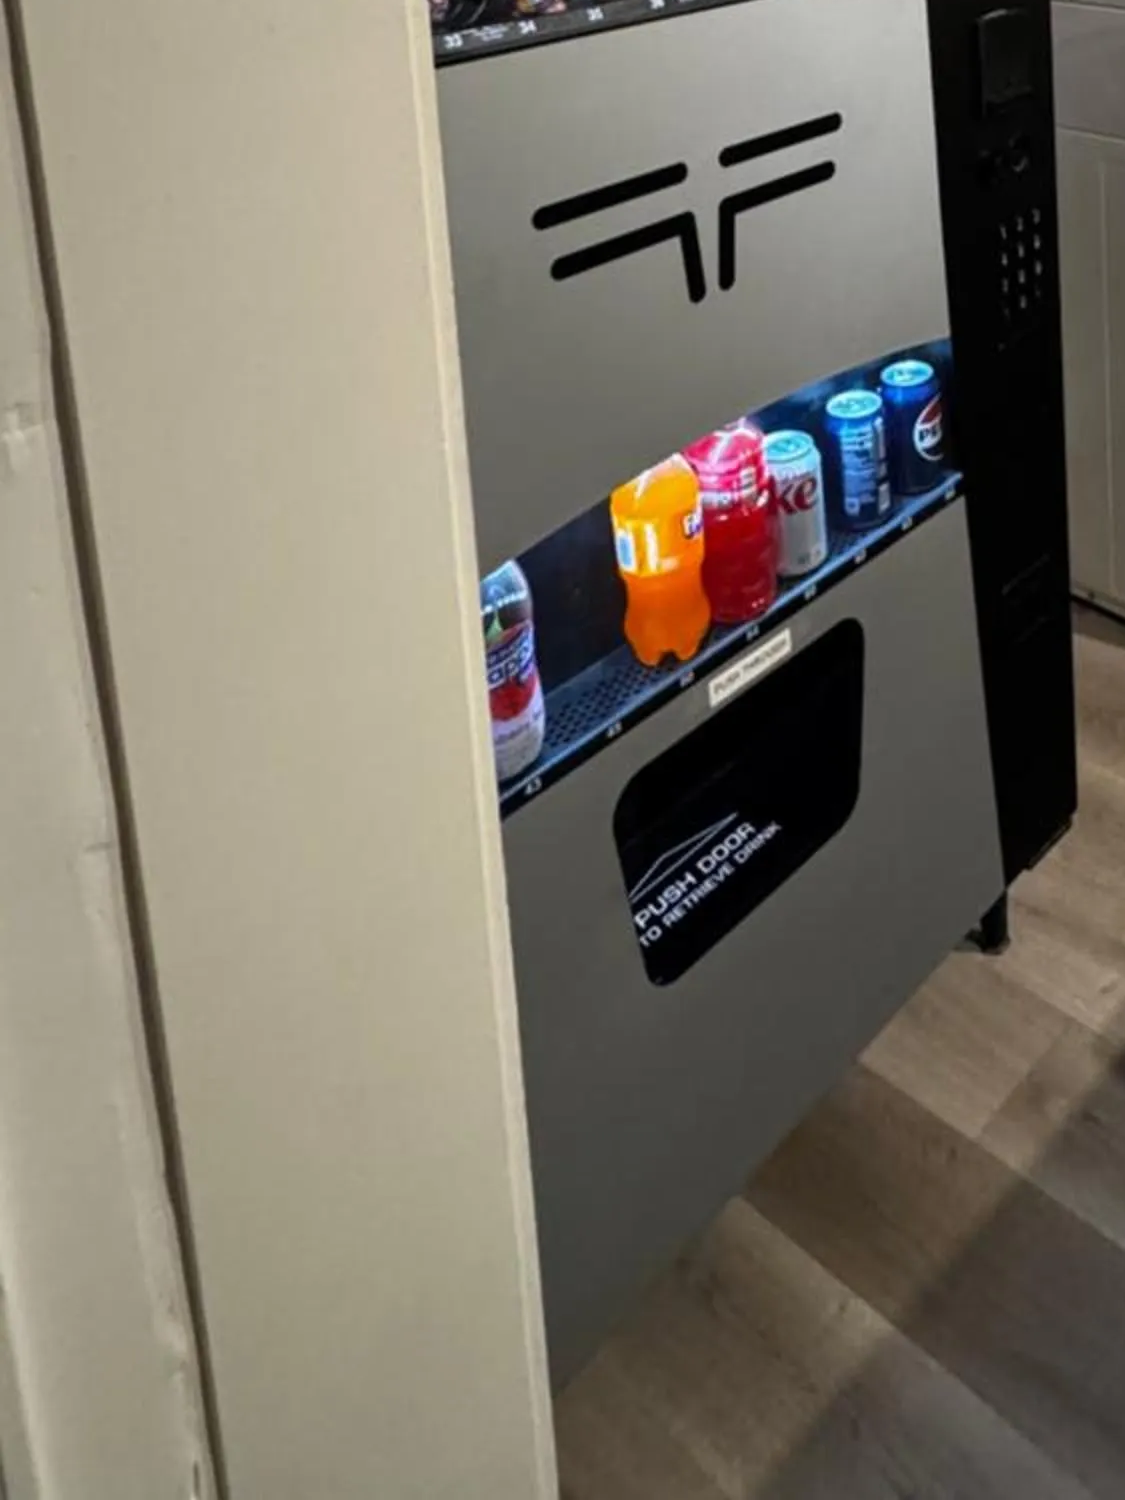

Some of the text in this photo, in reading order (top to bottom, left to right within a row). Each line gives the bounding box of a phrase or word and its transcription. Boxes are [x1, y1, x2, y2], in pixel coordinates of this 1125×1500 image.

[634, 822, 756, 929] PUSH DOOR
[639, 820, 782, 948] TO RETRIEVE DRINK
